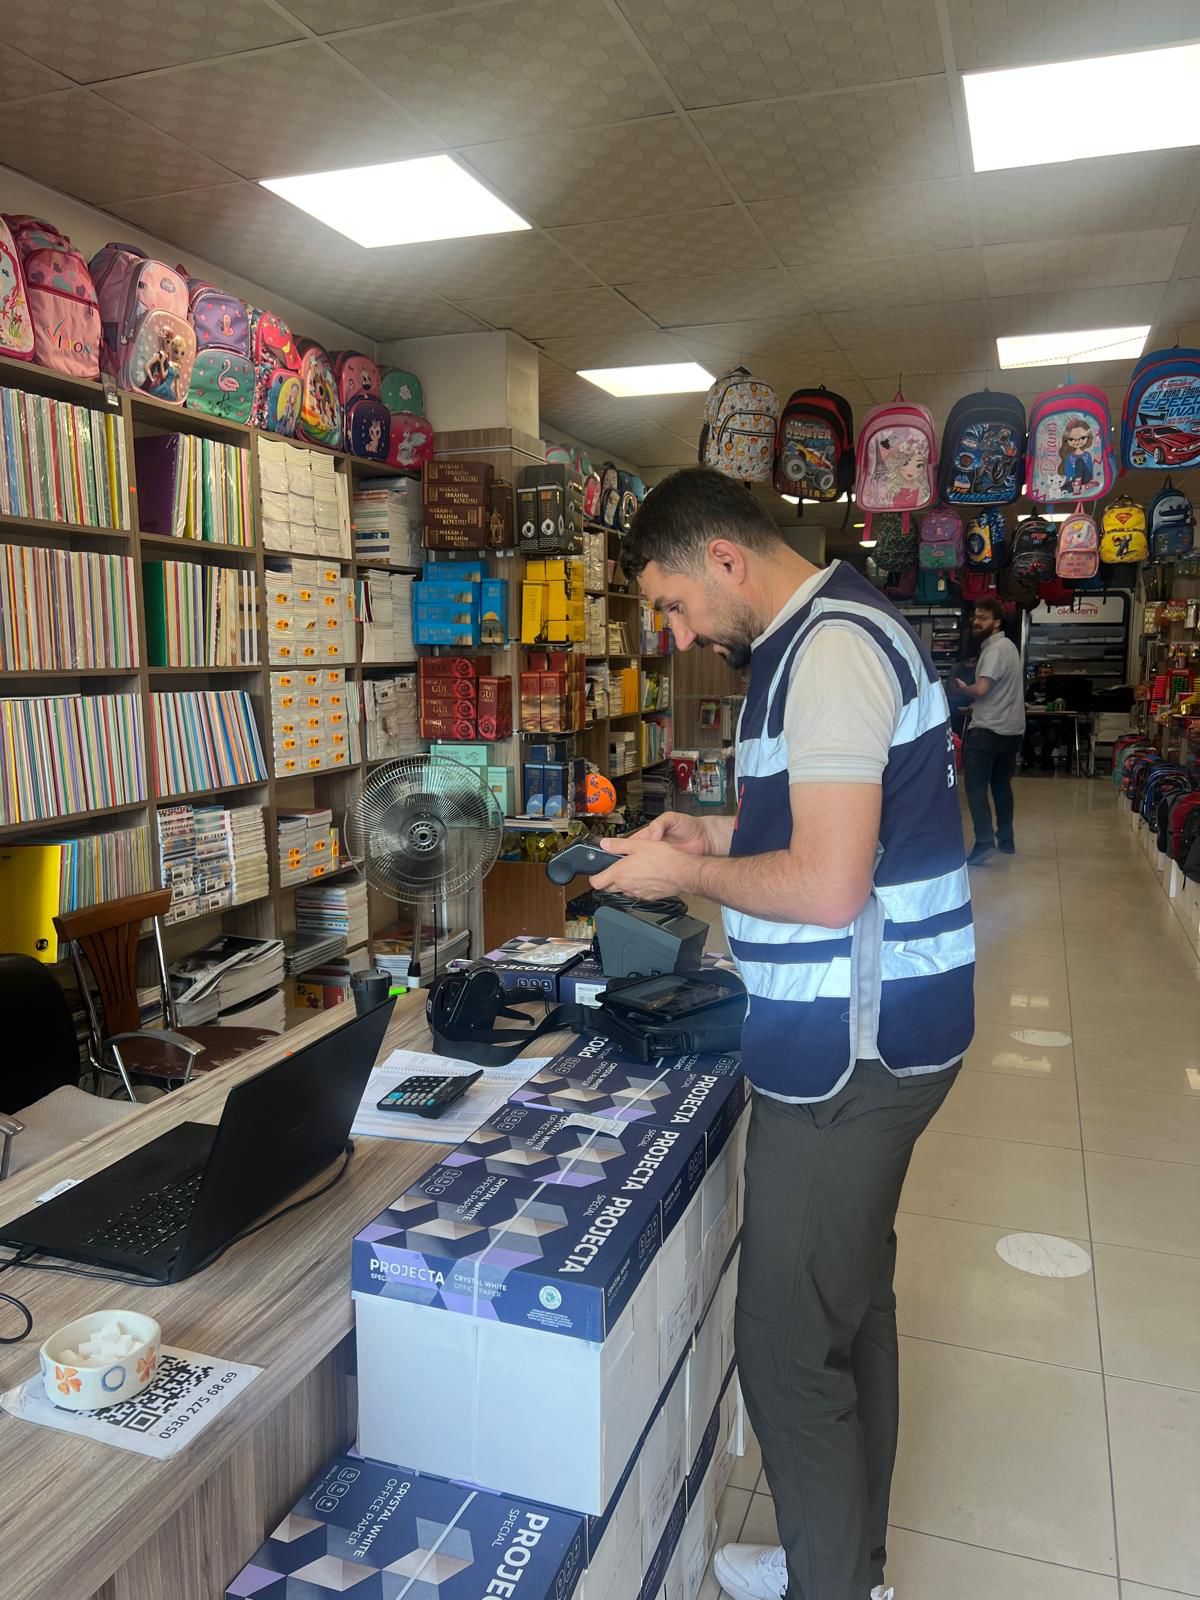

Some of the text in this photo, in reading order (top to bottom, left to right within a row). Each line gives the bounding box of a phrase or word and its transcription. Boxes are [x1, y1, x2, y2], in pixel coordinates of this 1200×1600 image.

[670, 1075, 718, 1123] PROJECTA
[621, 1130, 680, 1190] PROJECTA
[637, 1128, 657, 1148] SPECIAL
[456, 1176, 496, 1214] OFFICE PAPER
[462, 1178, 509, 1221] CRYSTAL WHITE
[583, 1194, 606, 1217] SPECIAL
[558, 1197, 633, 1272] PROJECTA
[370, 1258, 445, 1286] PROJECTA
[485, 1281, 507, 1292] WHITE
[159, 1372, 237, 1439] 0530 275 68 69
[345, 1478, 398, 1545] OFFICE PAPER
[353, 1482, 411, 1558] CRYSTAL WHITE
[491, 1508, 520, 1547] SPECIAL
[481, 1512, 550, 1600] PROJE
